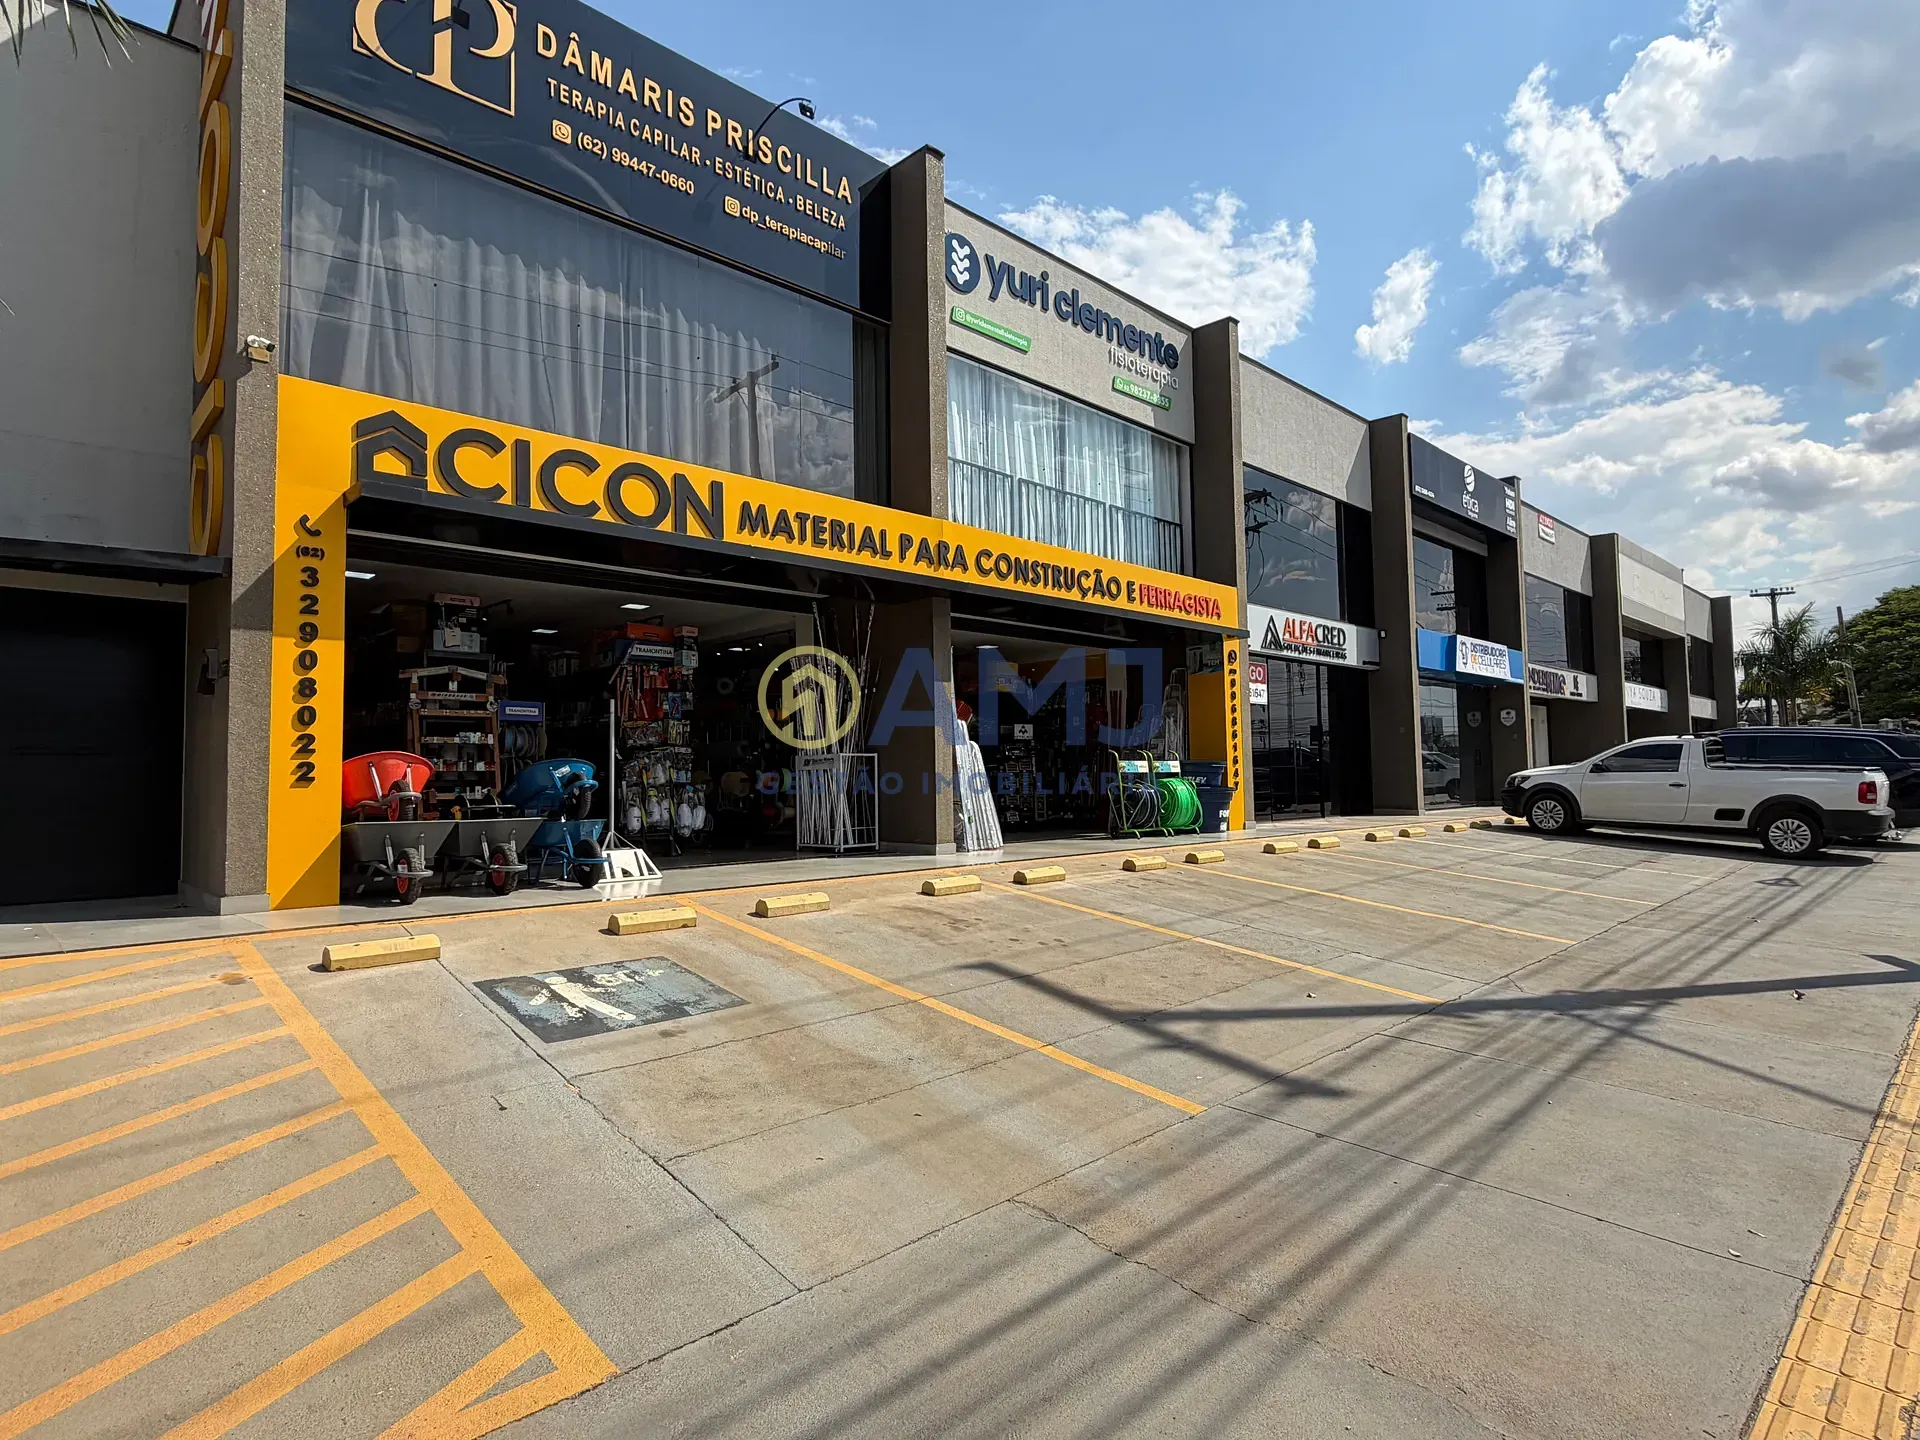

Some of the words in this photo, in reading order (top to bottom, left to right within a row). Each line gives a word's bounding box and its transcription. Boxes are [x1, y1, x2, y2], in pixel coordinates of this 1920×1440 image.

[536, 22, 696, 128] DÂMARIS
[706, 108, 853, 205] PRISCILLA
[547, 77, 625, 132] TERAPIA
[630, 117, 701, 167] CAPILAR
[714, 156, 785, 204] ESTÉTICA
[796, 194, 846, 231] BELEZA
[576, 131, 608, 160] (62)
[611, 147, 695, 195] 99447-0660
[741, 205, 847, 260] dp_terapiacapilar
[984, 253, 1050, 313] yuri
[1052, 287, 1180, 371] clemente
[1109, 345, 1180, 391] fisioterapia
[295, 545, 326, 561] (62)
[736, 500, 893, 560] MATERIAL
[898, 532, 969, 573] PARA
[973, 548, 1123, 602] CONSTRUÇÃO
[1125, 580, 1138, 602] E
[1138, 582, 1222, 620] FERRAGISTA
[634, 645, 674, 656] TRAMONTINA
[1282, 616, 1347, 648] ALFACRED
[1470, 641, 1507, 660] DISTRIBUIDORA
